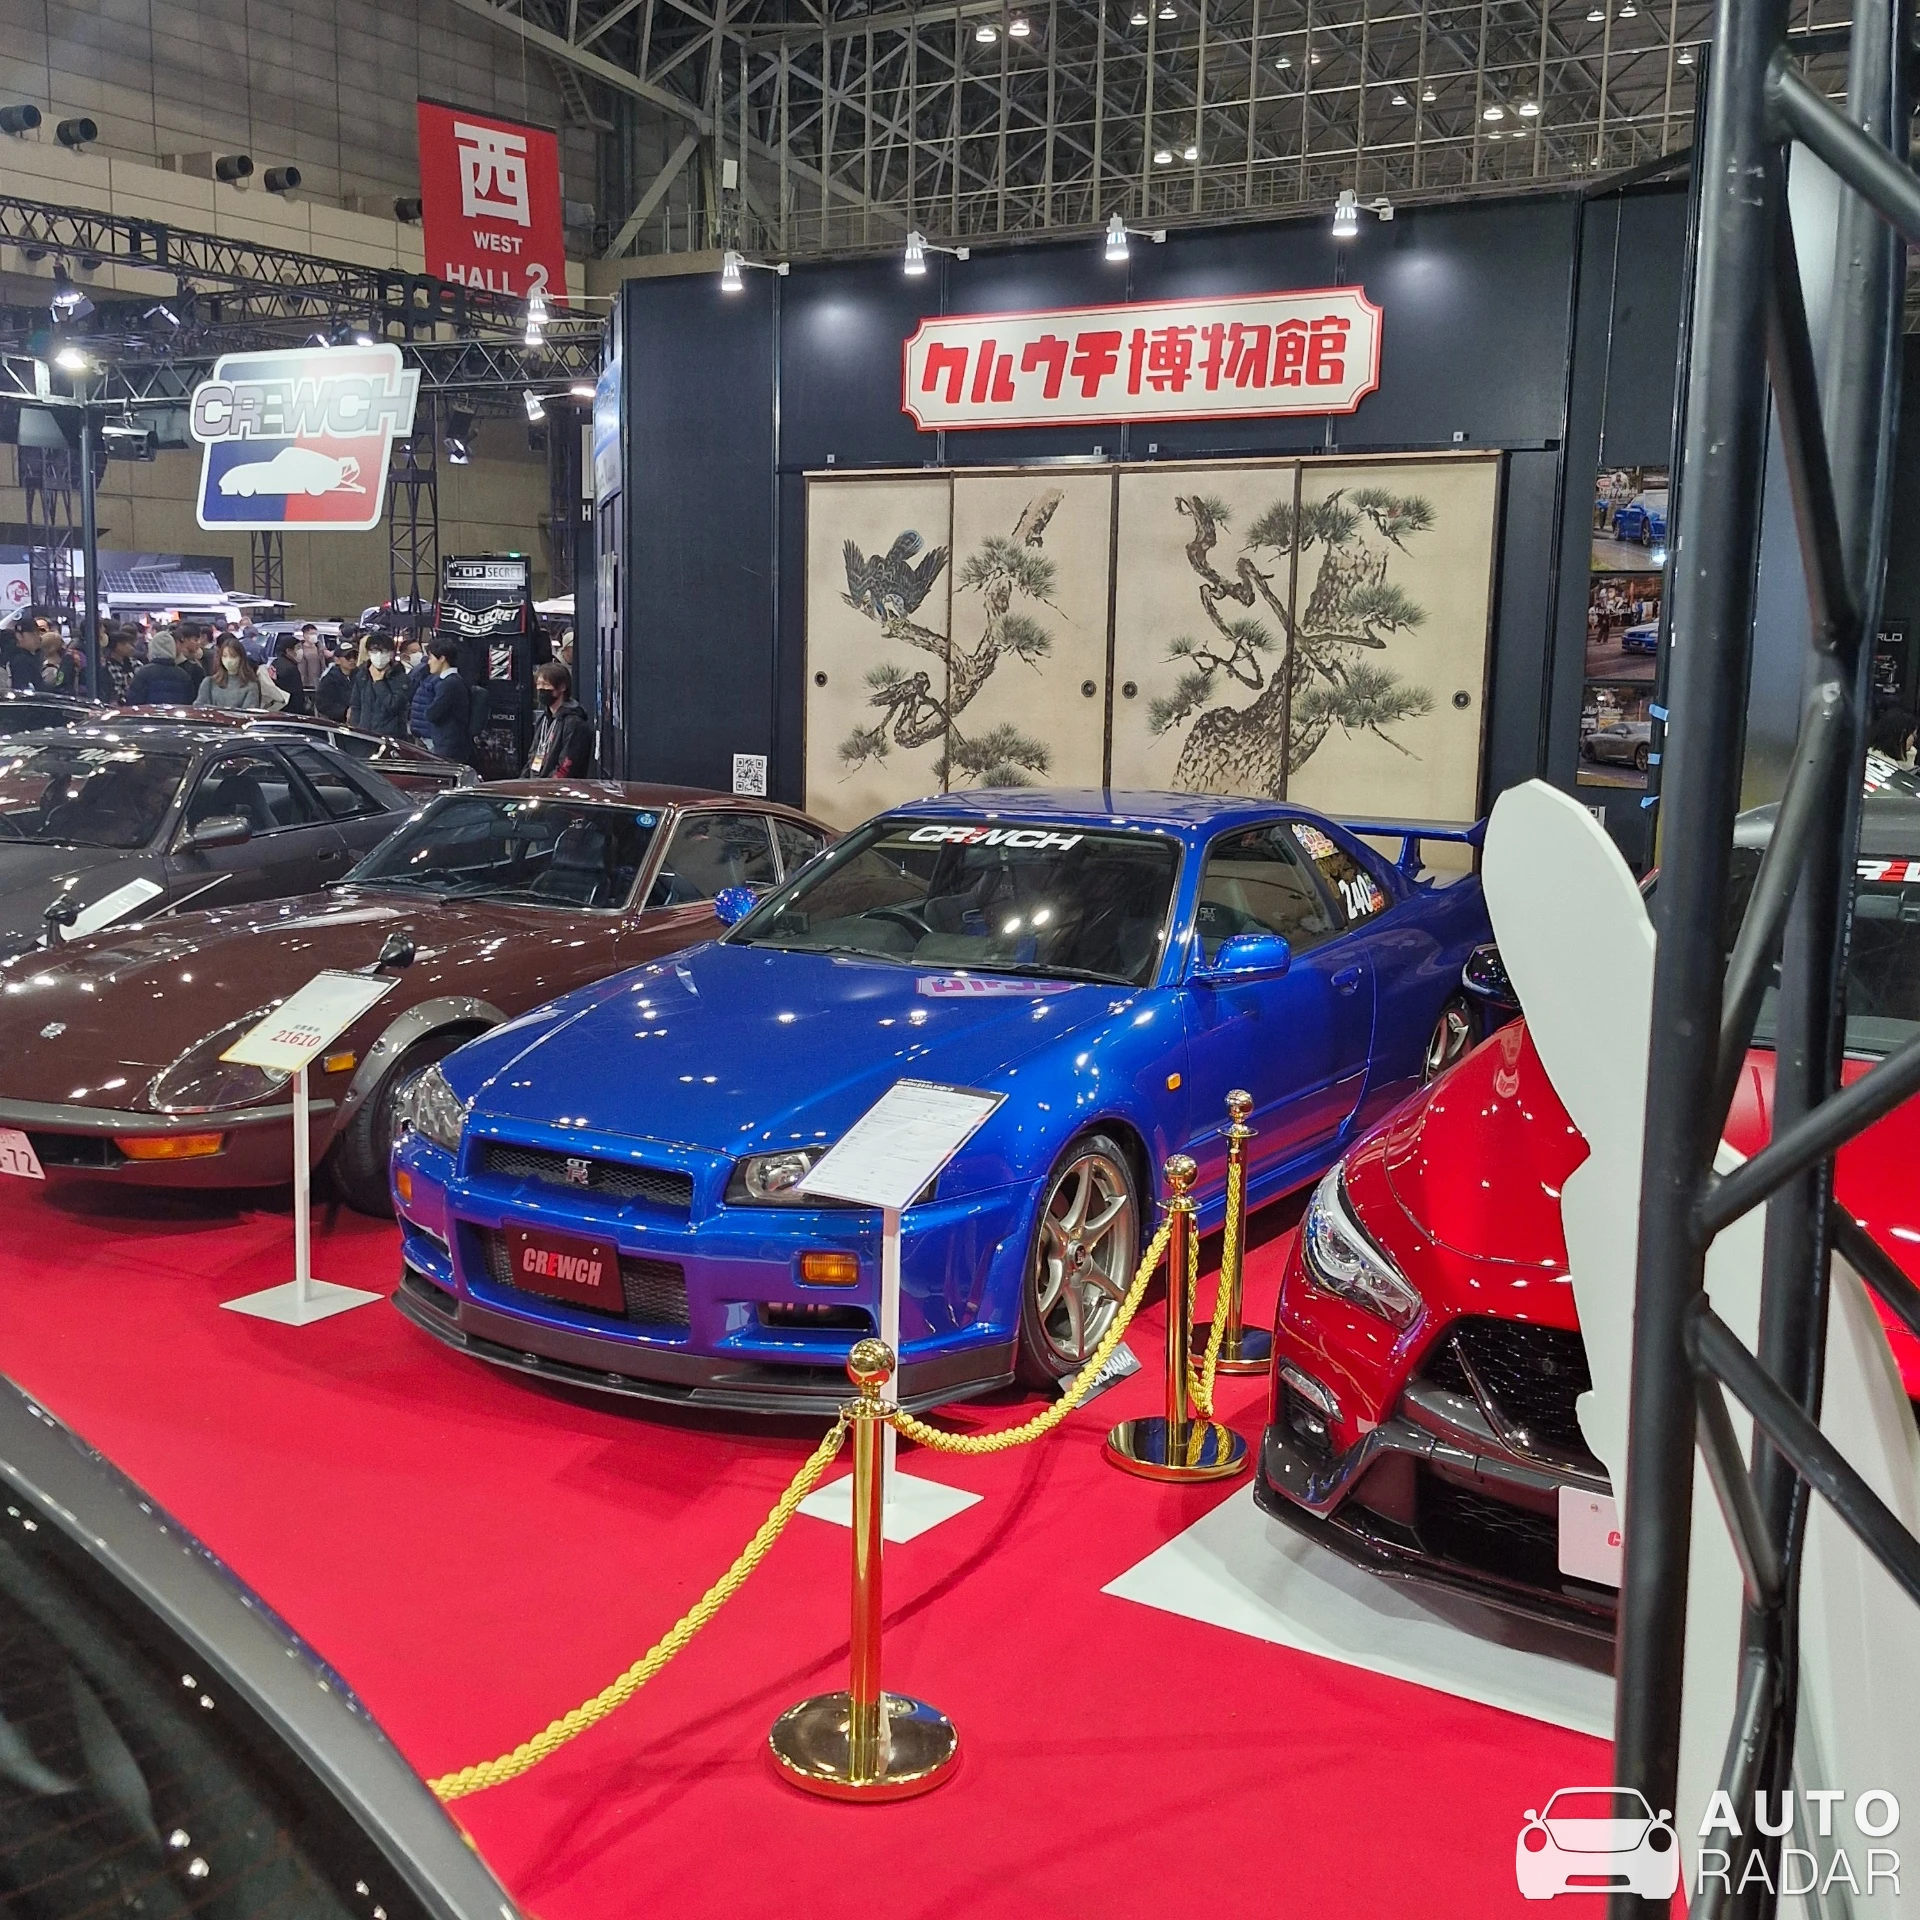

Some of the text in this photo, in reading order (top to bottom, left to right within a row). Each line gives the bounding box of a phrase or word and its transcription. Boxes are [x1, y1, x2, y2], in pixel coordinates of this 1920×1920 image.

[454, 121, 531, 228] 西
[473, 231, 523, 255] WEST
[446, 262, 549, 299] HALL 2
[921, 315, 1351, 404] クルウチ博物館
[194, 376, 414, 437] CREWCH
[487, 567, 522, 578] SECRET
[453, 608, 520, 625] TOP SECRET
[908, 825, 1084, 850] CREWCH
[1338, 874, 1374, 920] 240
[271, 1029, 322, 1048] 21610
[566, 1158, 592, 1168] GT
[522, 1248, 602, 1286] CREWCH
